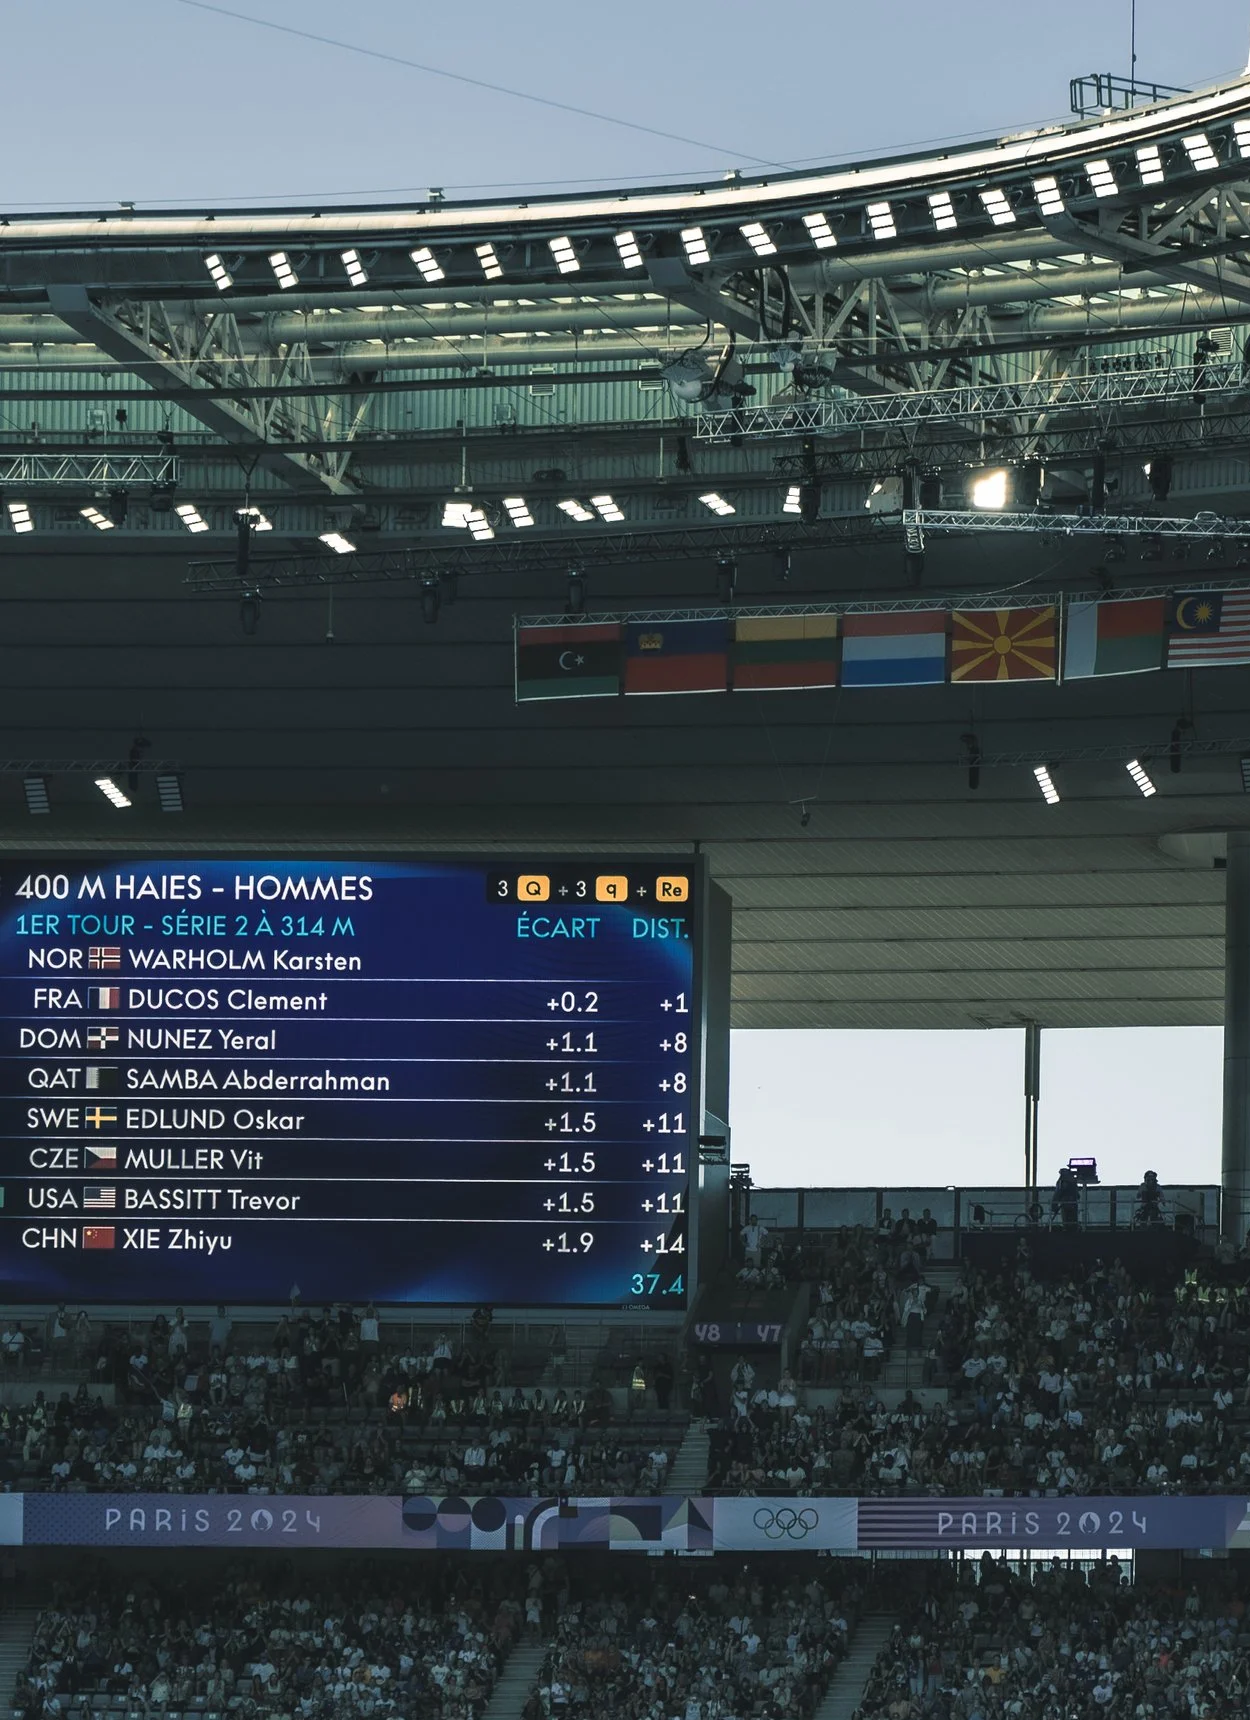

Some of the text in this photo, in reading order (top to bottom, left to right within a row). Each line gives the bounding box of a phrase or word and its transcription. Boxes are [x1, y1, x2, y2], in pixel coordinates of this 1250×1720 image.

[16, 875, 68, 899] 400
[78, 876, 105, 899] M
[116, 875, 201, 899] HAIES
[235, 875, 372, 900] HOMMES
[498, 881, 508, 898] 3
[524, 881, 542, 897] Q
[558, 885, 569, 896] +
[576, 881, 587, 898] 3
[636, 885, 647, 896] +
[661, 881, 682, 899] Re
[17, 915, 59, 934] 1ER
[67, 915, 134, 935] TOUR
[163, 910, 226, 935] SÉRIE
[236, 916, 247, 935] 2
[255, 909, 273, 935] À
[281, 916, 324, 935] 314
[332, 918, 354, 936] M
[518, 911, 688, 939] ÉCART DIST.
[29, 948, 360, 970] NOR WARHOLM Karsten
[35, 989, 688, 1012] FRA DUCOS Clement +0.2 +1
[21, 1028, 687, 1053] DOM NUNEZ Yeral +1.1 +8
[29, 1068, 686, 1093] QAT SAMBA Abderrahman +1.1 +8
[28, 1108, 686, 1133] SWE EDLUND Oskar +1.5 +11
[30, 1148, 685, 1173] CZE MULLER Vit +1.5 +11
[29, 1188, 684, 1213] USA BASSITT Trevor +1.5 +11
[23, 1228, 684, 1255] CHN XIE Zhiyu +1.9 +14
[631, 1274, 683, 1294] 37.4
[695, 1323, 782, 1342] Y8 Y7
[105, 1507, 322, 1534] PARIS 2024
[938, 1511, 1147, 1536] PARIS 2024
